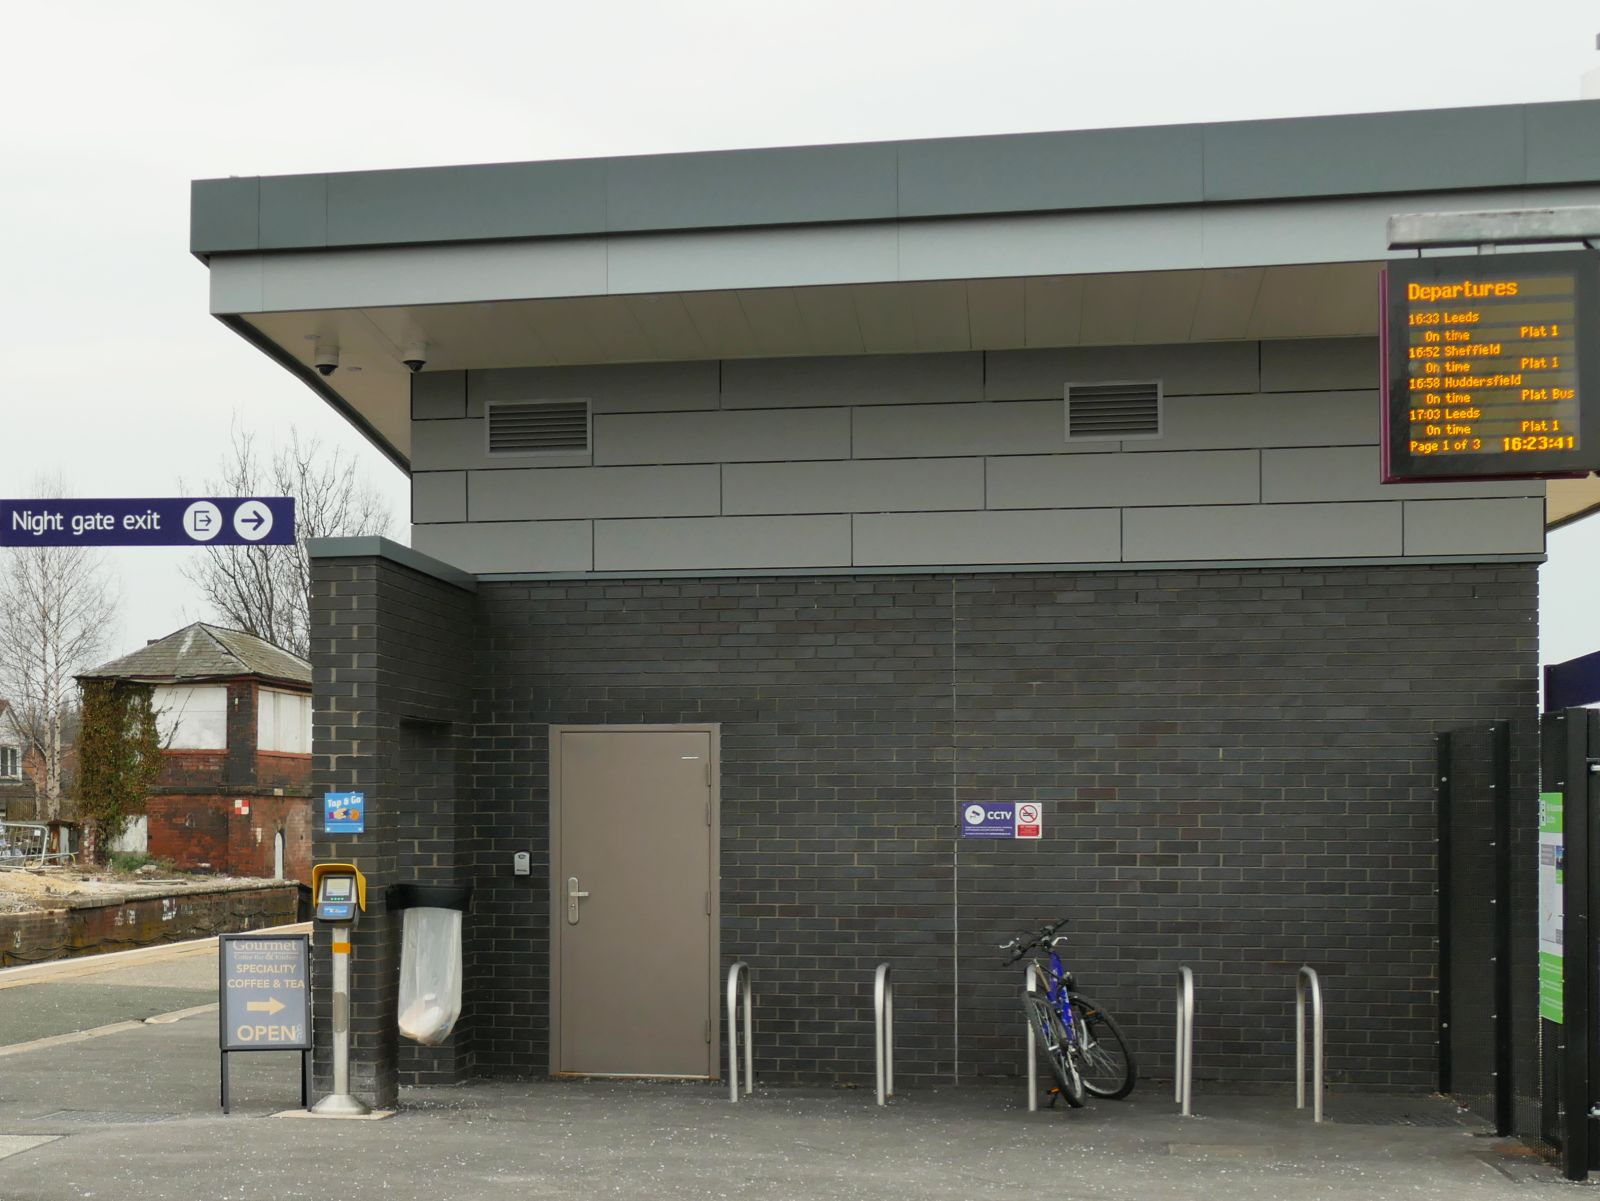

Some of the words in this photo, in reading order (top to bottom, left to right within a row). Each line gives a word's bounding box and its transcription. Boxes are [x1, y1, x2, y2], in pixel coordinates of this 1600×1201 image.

[1408, 280, 1518, 302] Departures
[1408, 312, 1440, 325] 16:33
[1444, 311, 1480, 324] Leeds
[1425, 331, 1440, 342] On
[1445, 329, 1470, 341] time
[1520, 326, 1547, 338] Plat
[1551, 325, 1559, 337] 1
[1408, 346, 1440, 359] 16:52
[1444, 343, 1501, 357] Sheffield
[1425, 362, 1440, 374] On
[1445, 361, 1470, 373] time
[1521, 358, 1548, 369] Plat
[1552, 356, 1559, 368] 1
[1409, 377, 1441, 390] 16:58
[1445, 374, 1522, 388] Huddersfield
[1426, 393, 1441, 405] On
[1445, 392, 1471, 404] time
[1521, 389, 1548, 401] Plat
[1552, 388, 1576, 400] Bus
[1409, 409, 1441, 421] 17:03
[1445, 407, 1481, 419] Leeds
[1426, 424, 1441, 436] On
[1446, 424, 1472, 435] time
[1521, 420, 1548, 433] Plat
[1552, 420, 1560, 432] 1
[1410, 441, 1439, 454] Page
[1443, 440, 1450, 451] 1
[1454, 438, 1468, 450] of
[1473, 438, 1481, 449] 3
[1503, 436, 1576, 452] 16:23:41
[12, 510, 64, 536] Night
[71, 513, 115, 535] gate
[123, 510, 161, 530] exit
[328, 799, 342, 809] Tap
[351, 795, 362, 804] Go
[987, 811, 1012, 820] CCTV
[232, 940, 297, 951] Gourmet
[236, 963, 297, 974] SPECIALITY
[227, 979, 270, 989] COFFEE
[273, 980, 281, 988] &
[285, 979, 305, 989] TEA
[237, 1025, 297, 1042] OPEN
